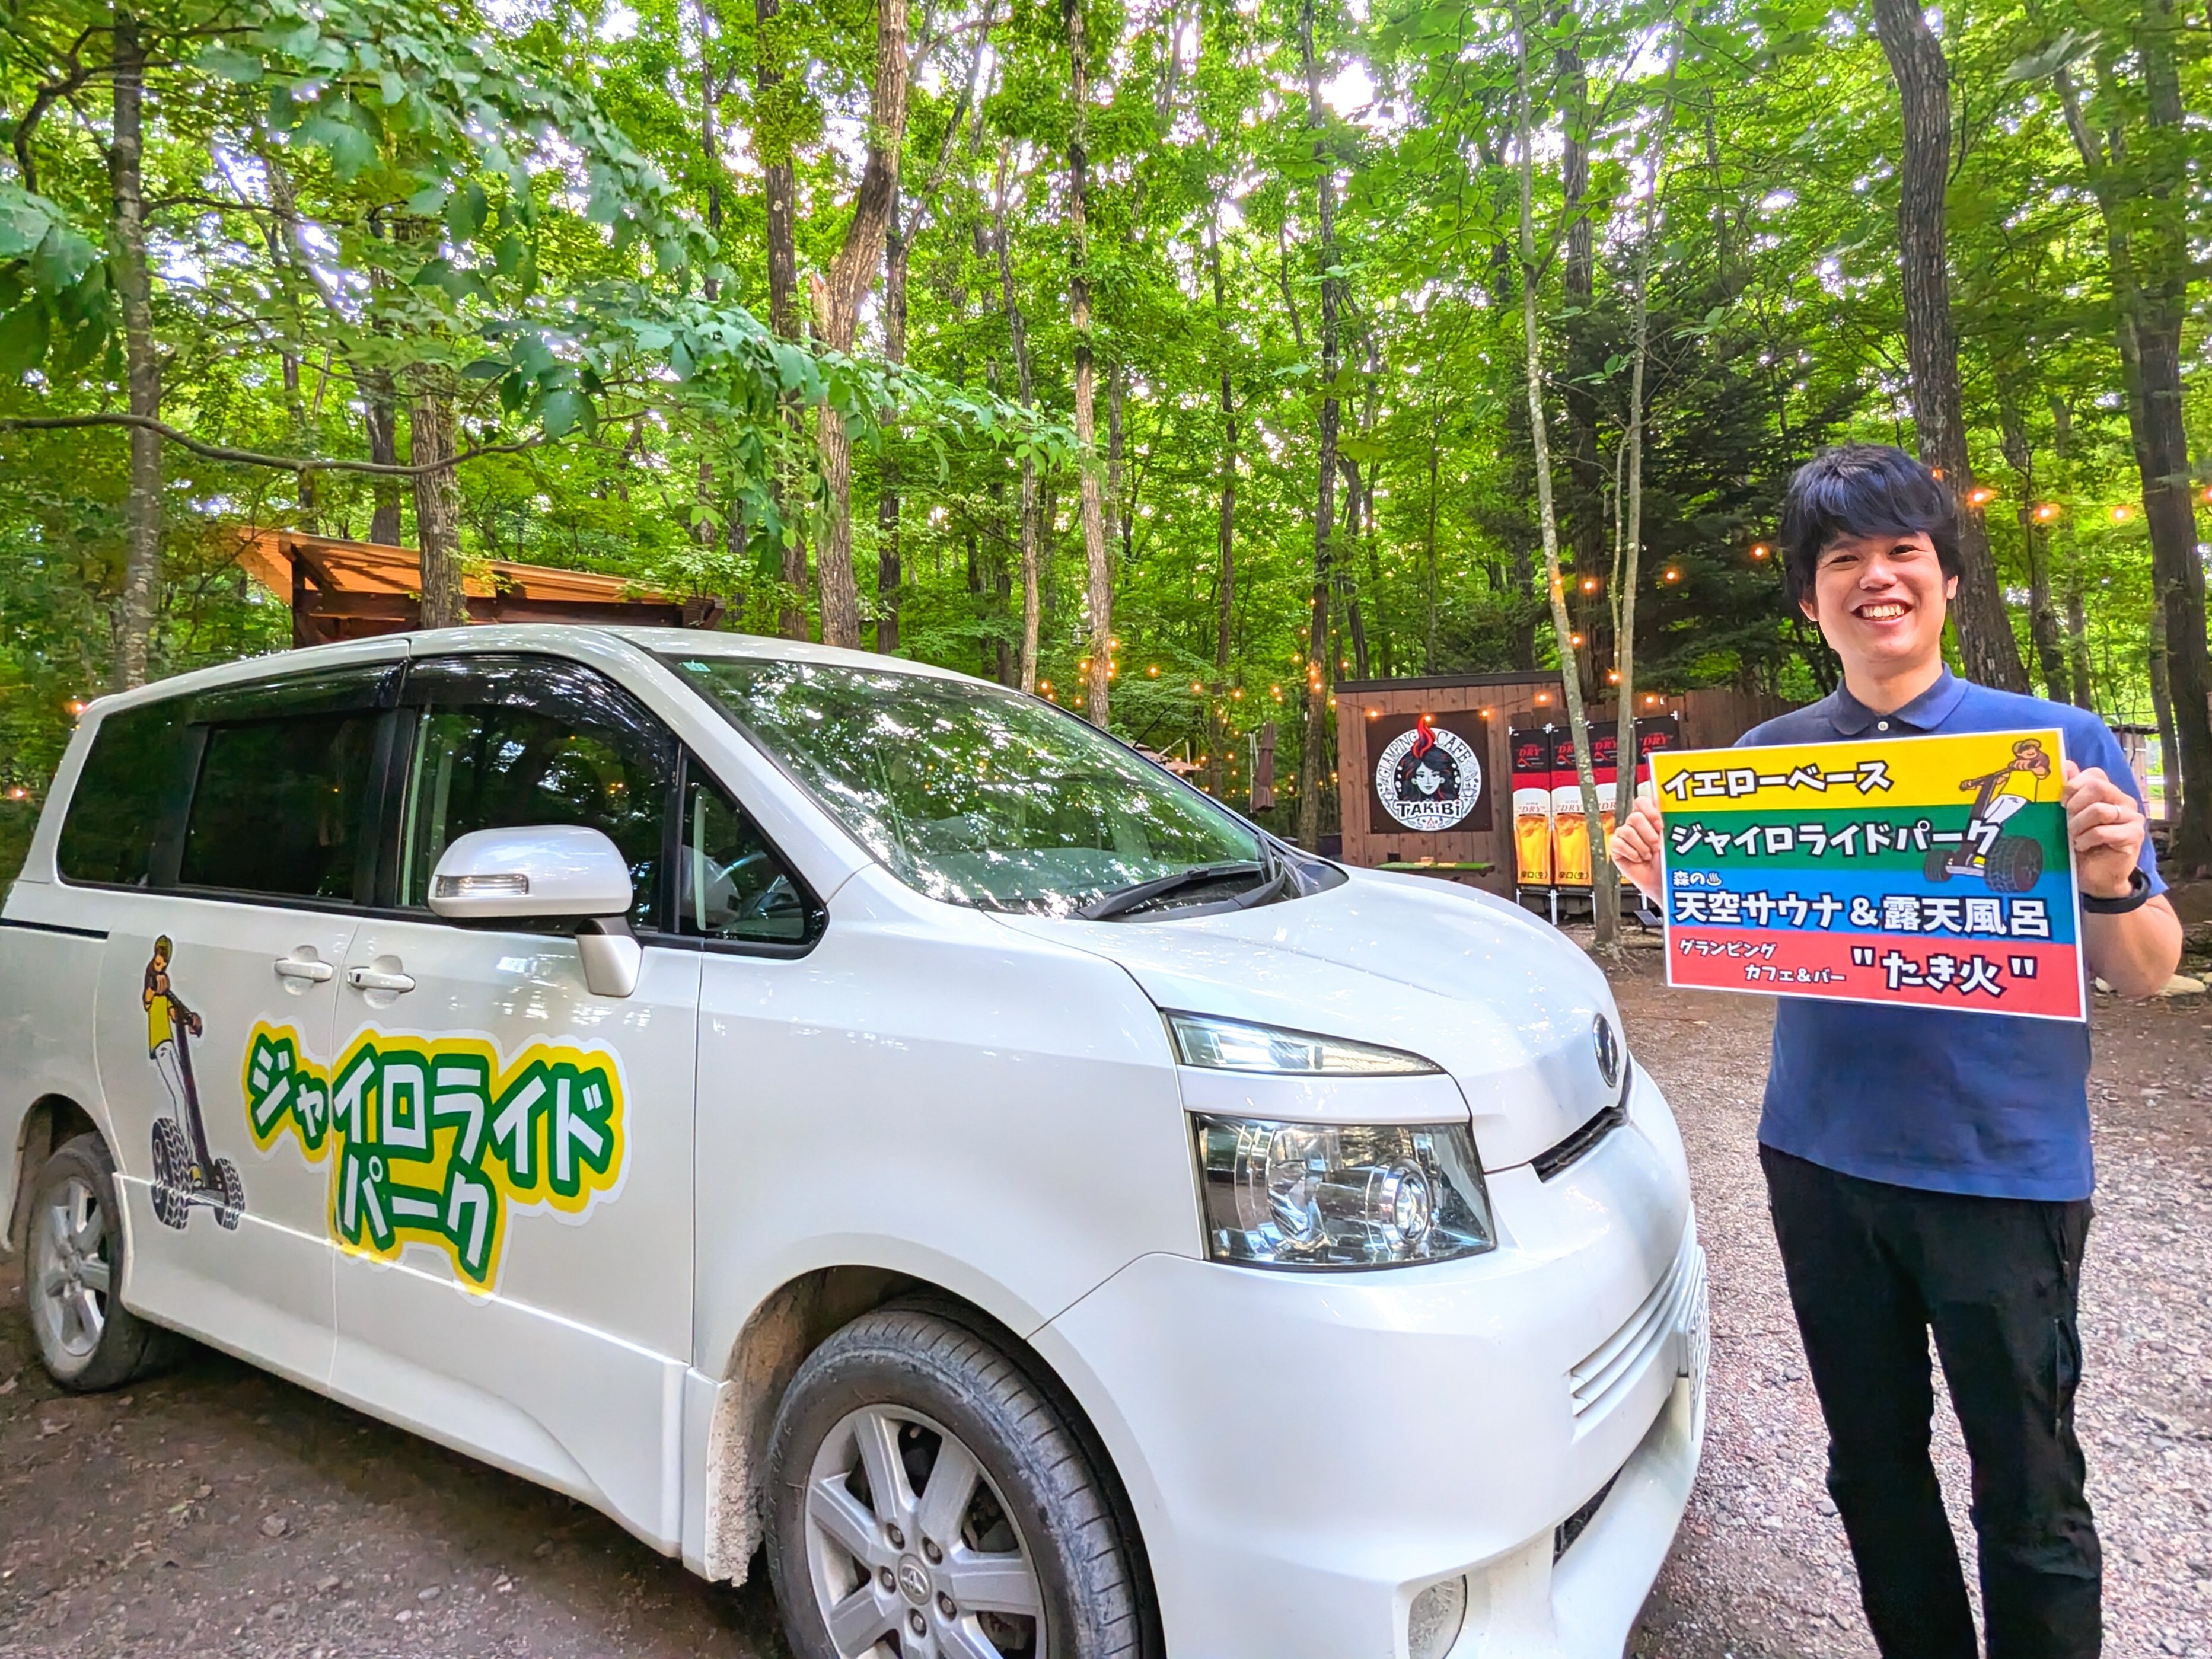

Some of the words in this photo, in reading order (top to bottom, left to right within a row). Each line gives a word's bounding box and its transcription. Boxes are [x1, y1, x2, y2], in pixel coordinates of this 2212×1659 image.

[1378, 731, 1417, 778] GLAMPING
[1436, 731, 1472, 763] CAFE
[1558, 745, 1574, 754] DR
[1662, 761, 1893, 800] イエローベース
[1671, 819, 2001, 856] ジャイロライドパーク
[1679, 939, 1777, 960] グランピング
[1745, 964, 1846, 984] カフェ&バー
[250, 1041, 609, 1189] ジャイロライド
[340, 1149, 495, 1276] パーク
